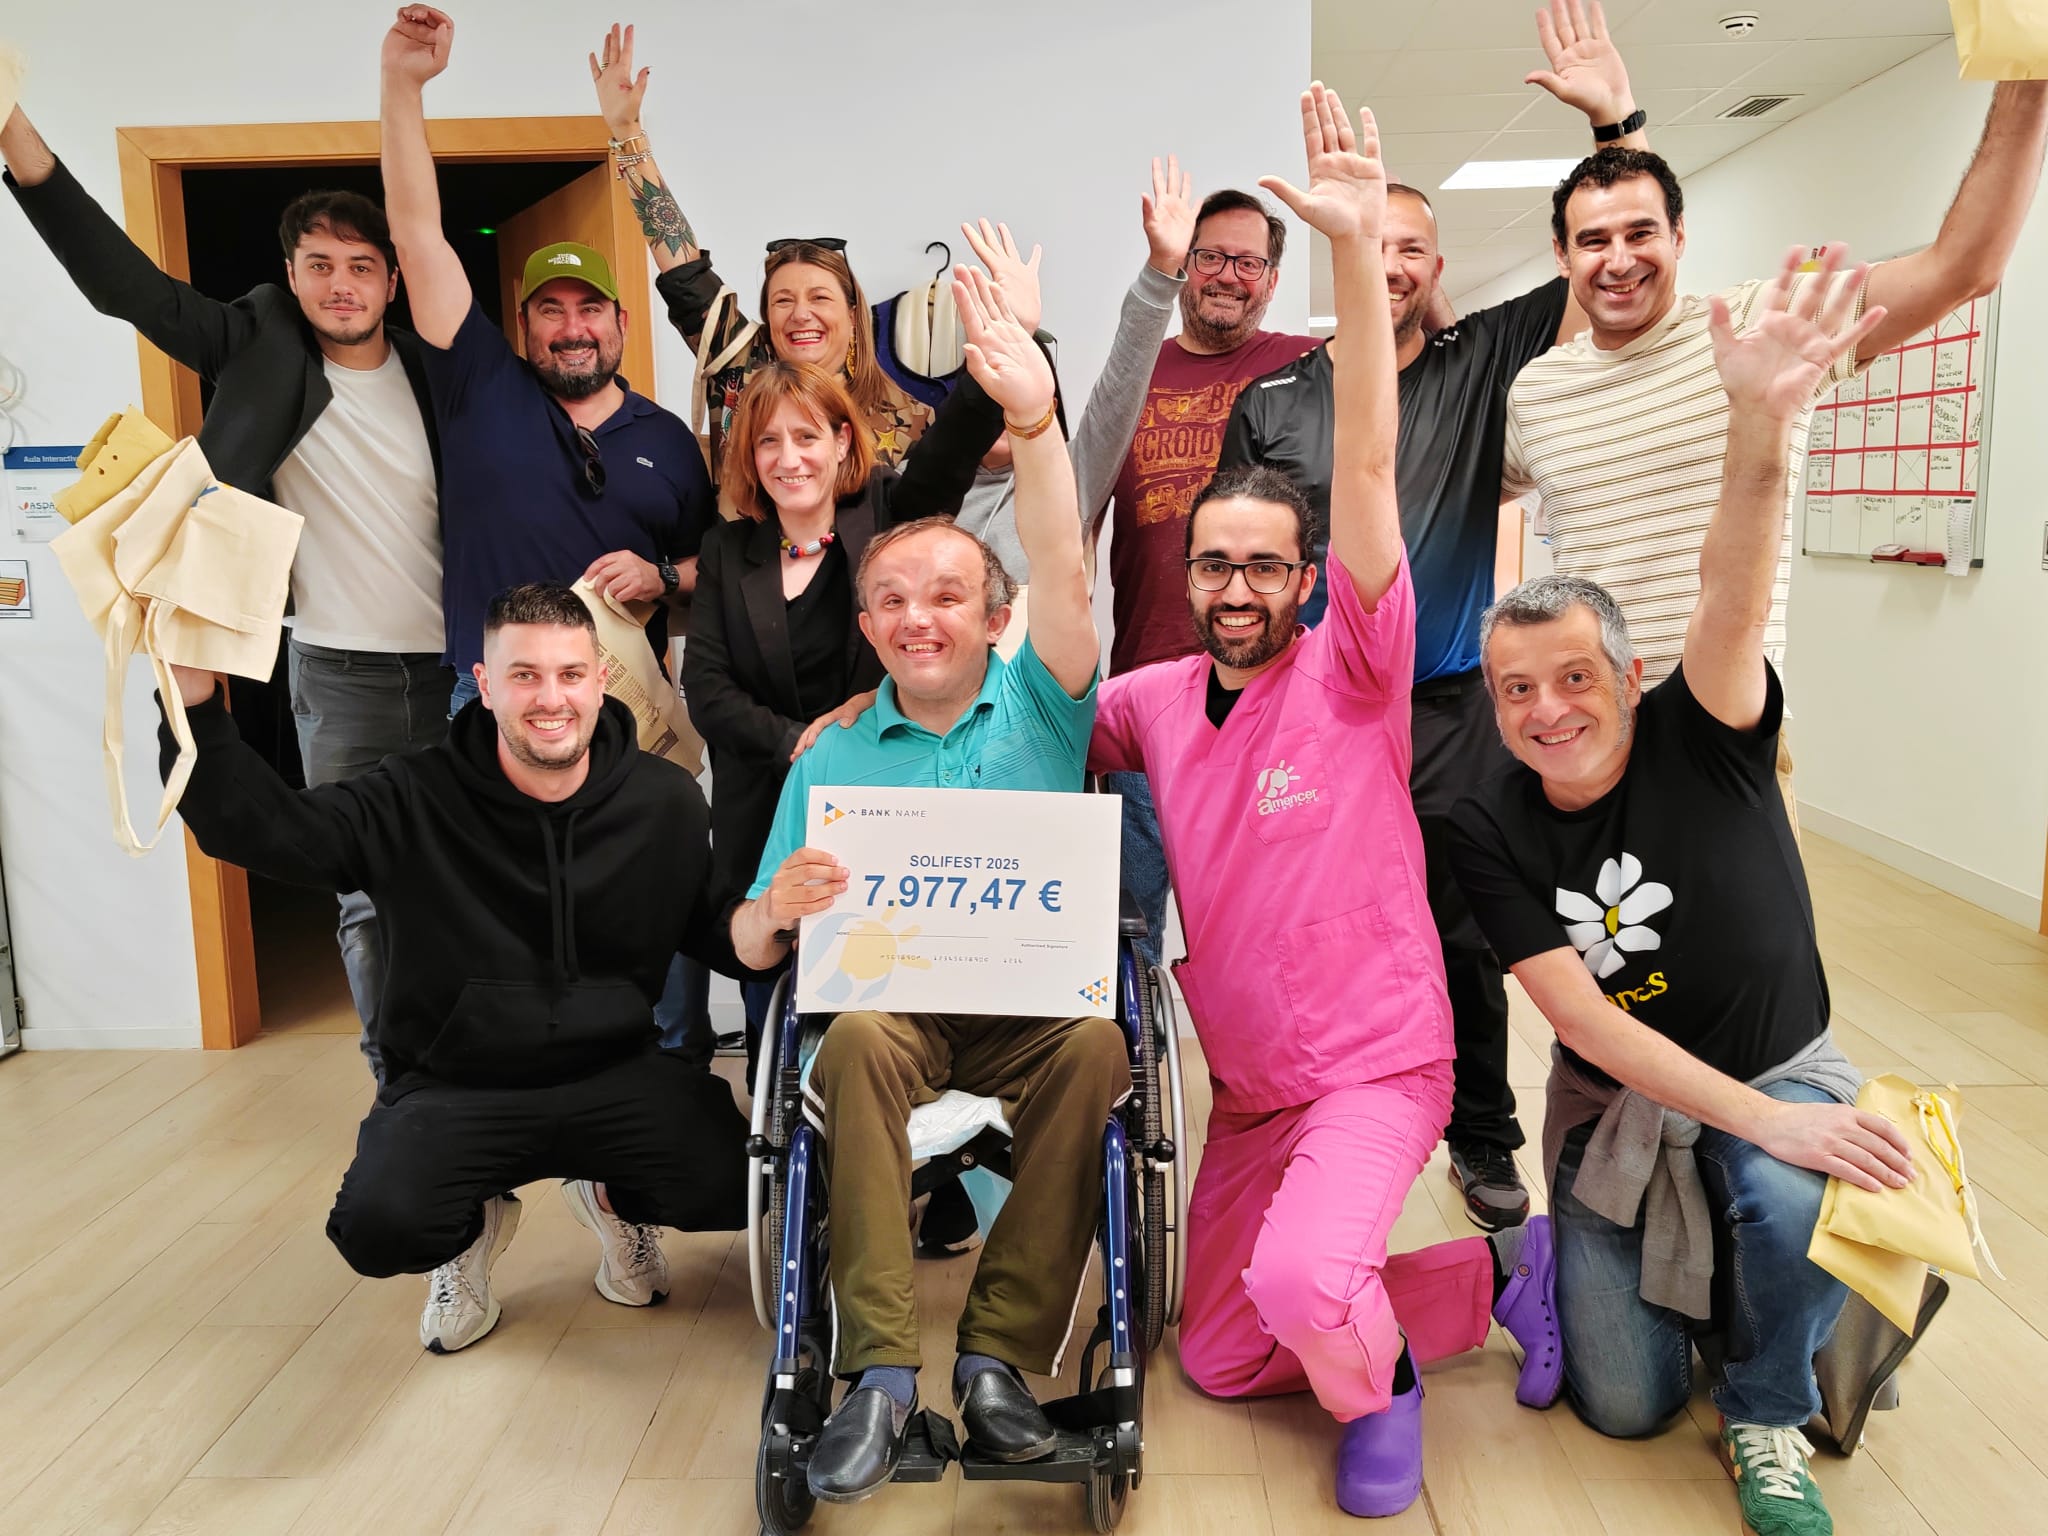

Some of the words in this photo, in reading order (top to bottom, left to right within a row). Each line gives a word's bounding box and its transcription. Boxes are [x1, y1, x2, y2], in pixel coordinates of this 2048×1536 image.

[23, 455, 41, 463] Aula
[42, 455, 77, 463] Interactiv
[1257, 789, 1318, 816] amencer
[861, 808, 891, 817] BANK
[895, 809, 927, 818] NAME
[909, 855, 982, 869] SOLIFEST
[986, 857, 1020, 870] 2025
[864, 874, 1026, 915] 7.977,47
[1038, 880, 1062, 912] €
